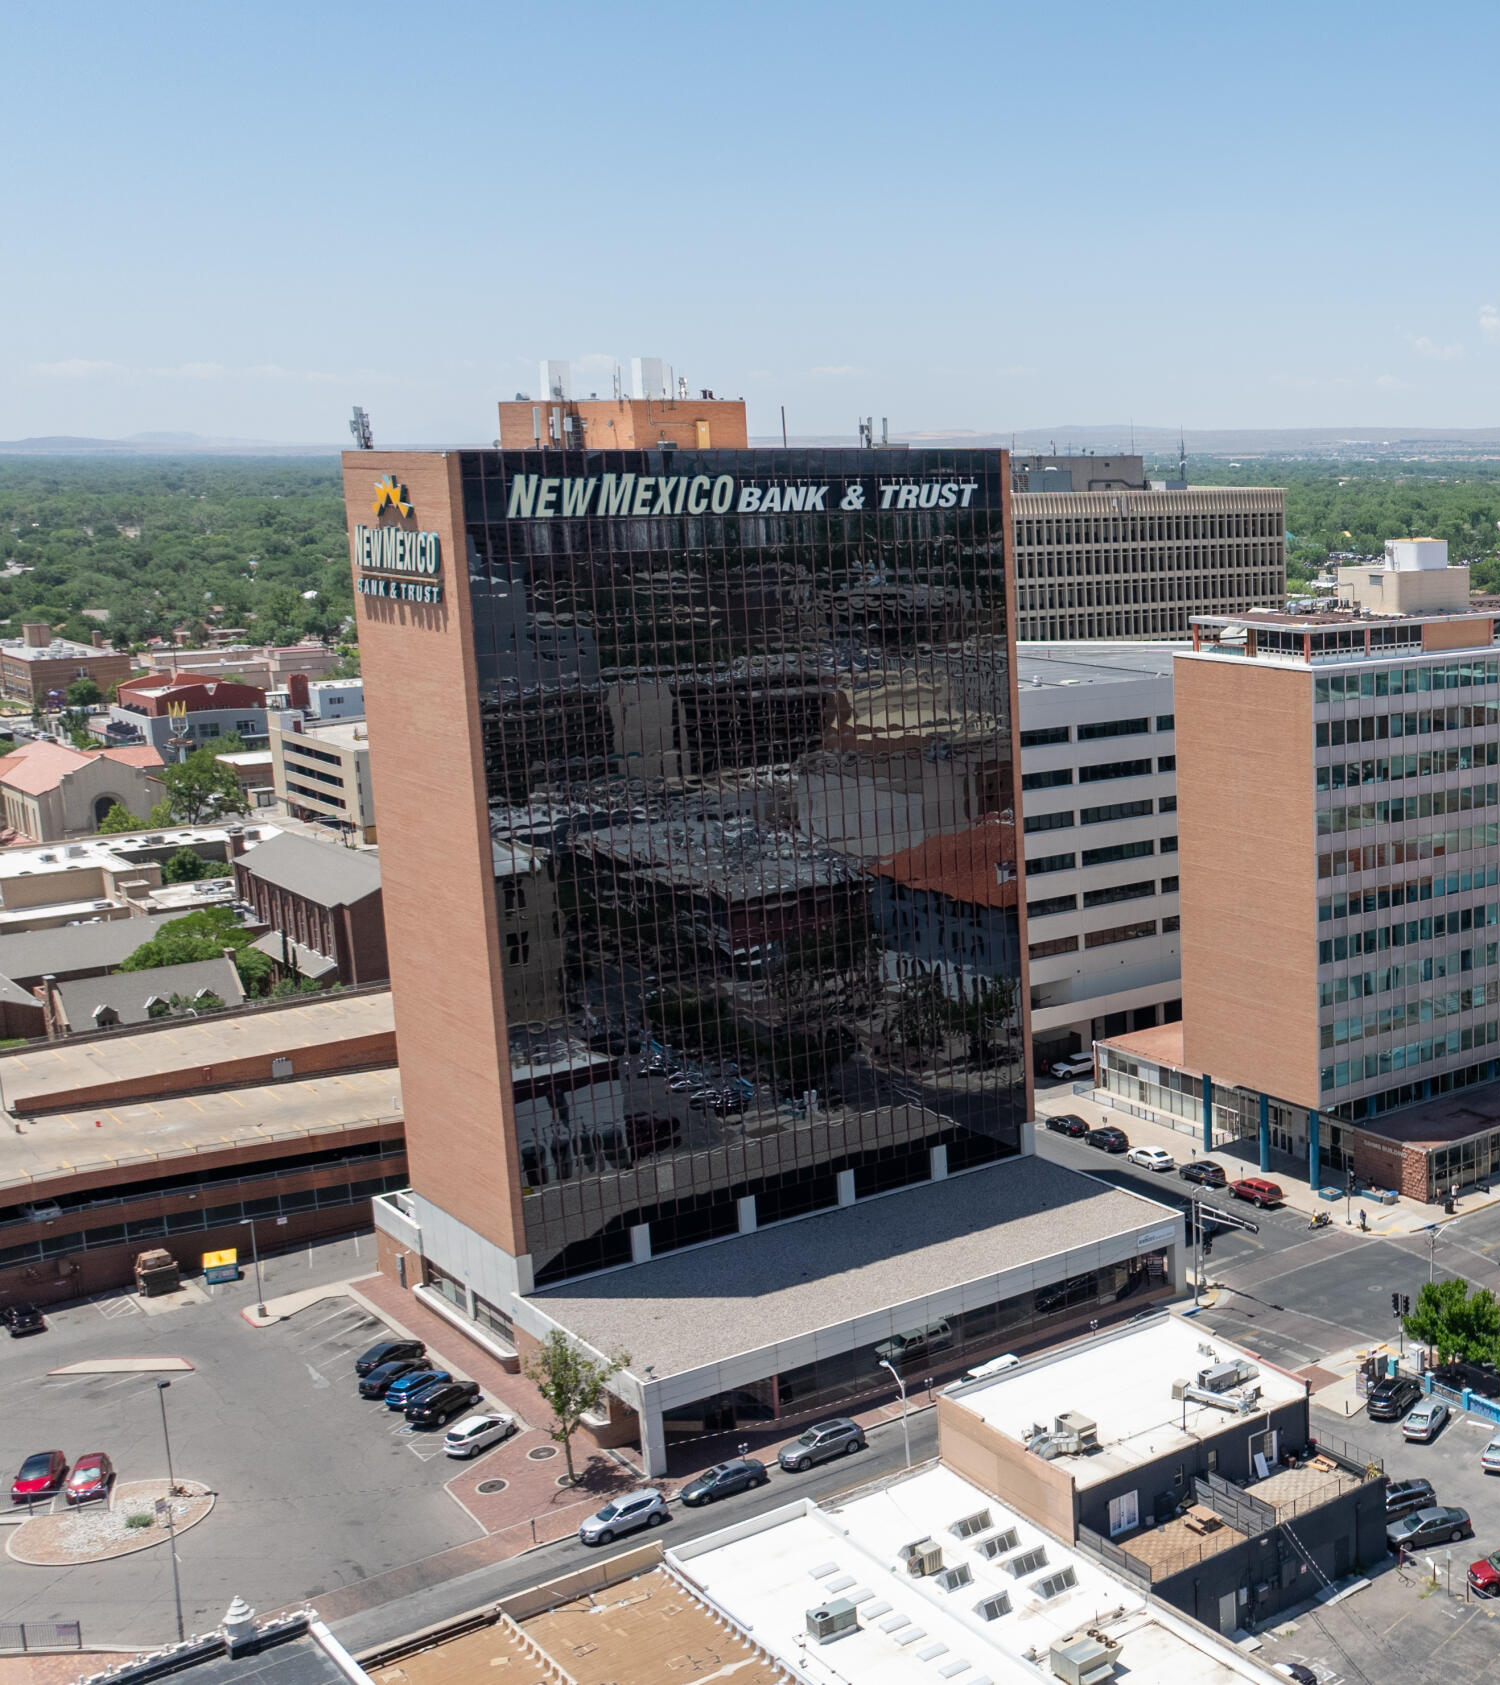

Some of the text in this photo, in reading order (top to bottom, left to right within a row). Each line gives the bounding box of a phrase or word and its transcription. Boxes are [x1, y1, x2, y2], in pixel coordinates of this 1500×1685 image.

[737, 486, 830, 512] BANK
[840, 485, 866, 510] &
[879, 482, 978, 509] TRUST
[357, 578, 440, 604] BANK & TRUST
